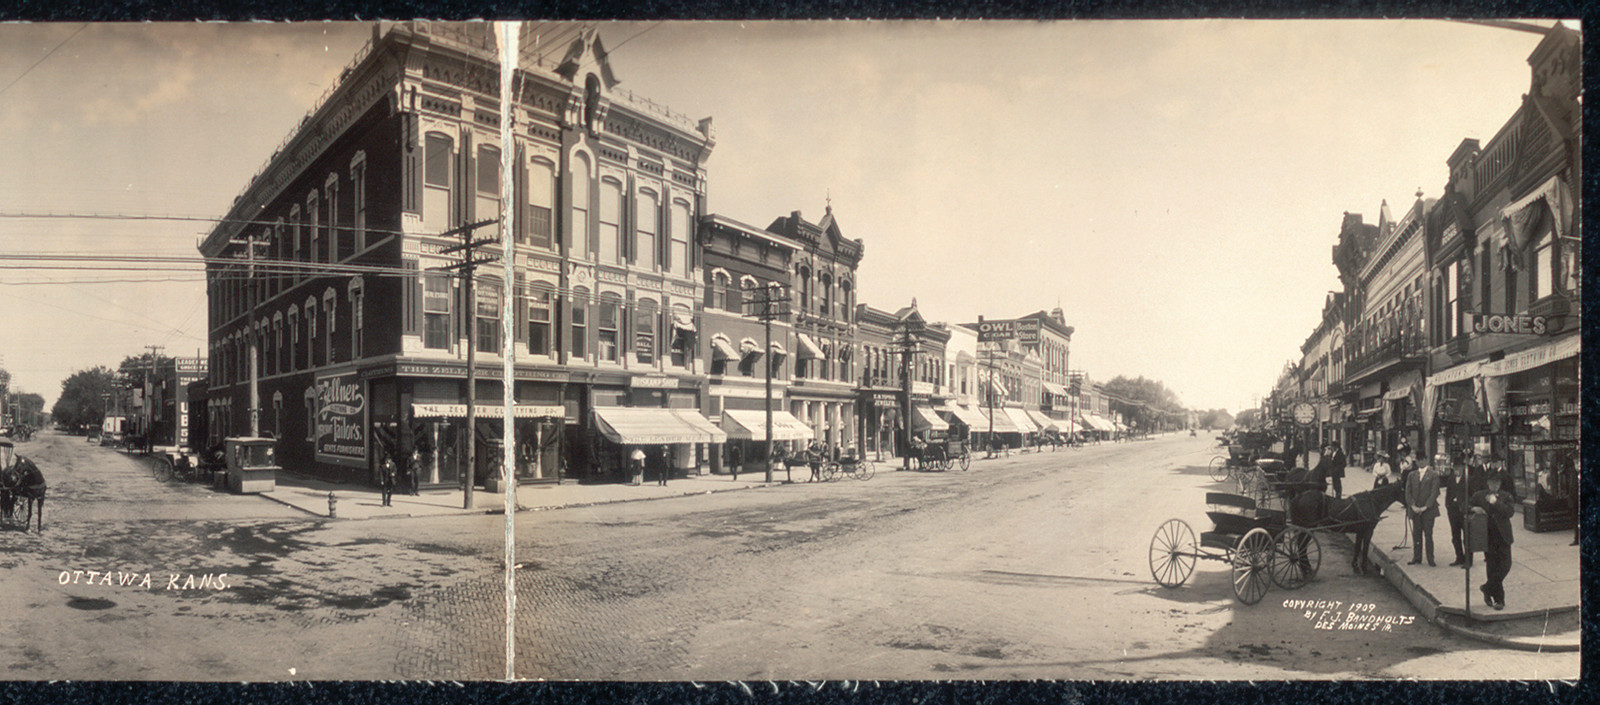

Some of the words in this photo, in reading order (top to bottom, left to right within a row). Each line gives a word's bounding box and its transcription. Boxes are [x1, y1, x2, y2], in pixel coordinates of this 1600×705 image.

[980, 323, 1013, 332] OWL
[1474, 314, 1547, 335] JONES
[401, 366, 428, 374] THE
